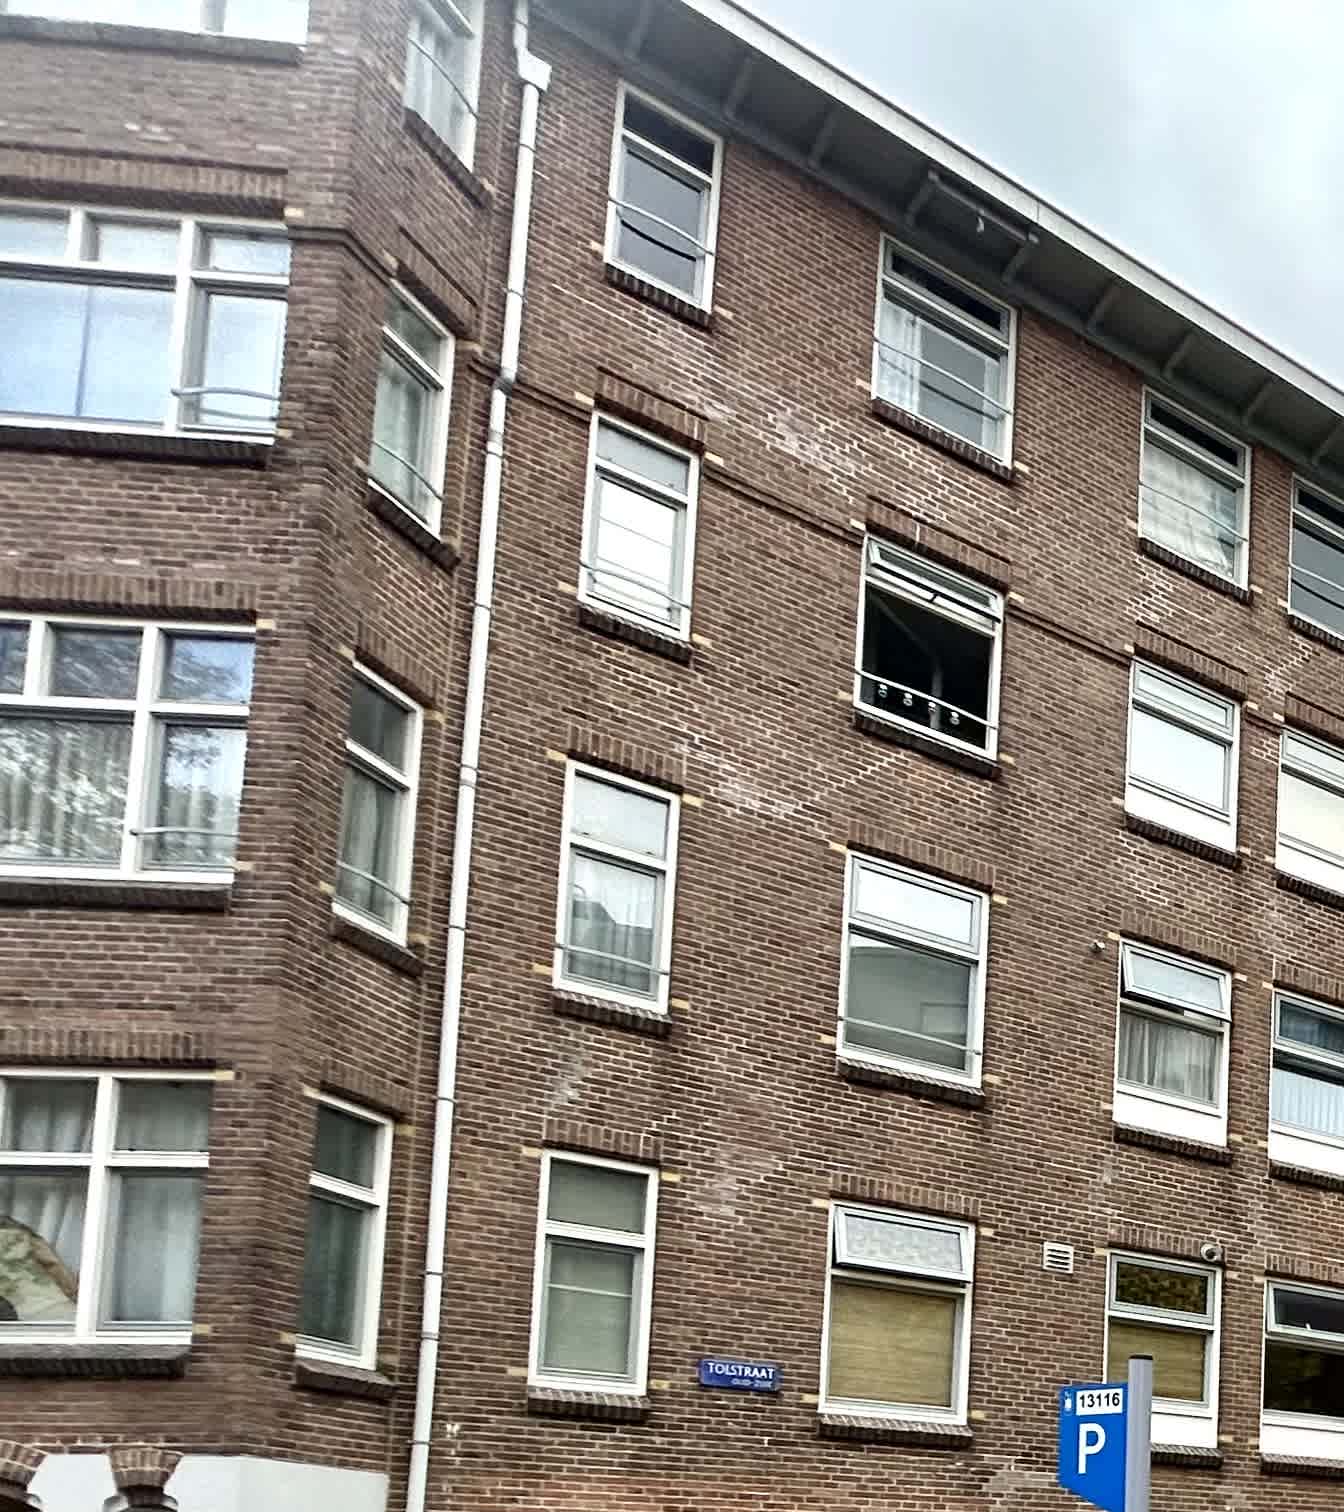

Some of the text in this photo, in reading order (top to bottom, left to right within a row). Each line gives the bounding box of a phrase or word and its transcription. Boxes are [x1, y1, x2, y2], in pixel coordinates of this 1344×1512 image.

[707, 1362, 775, 1379] TOLSTRAAT
[1079, 1392, 1120, 1408] 13116
[1078, 1422, 1106, 1474] P
